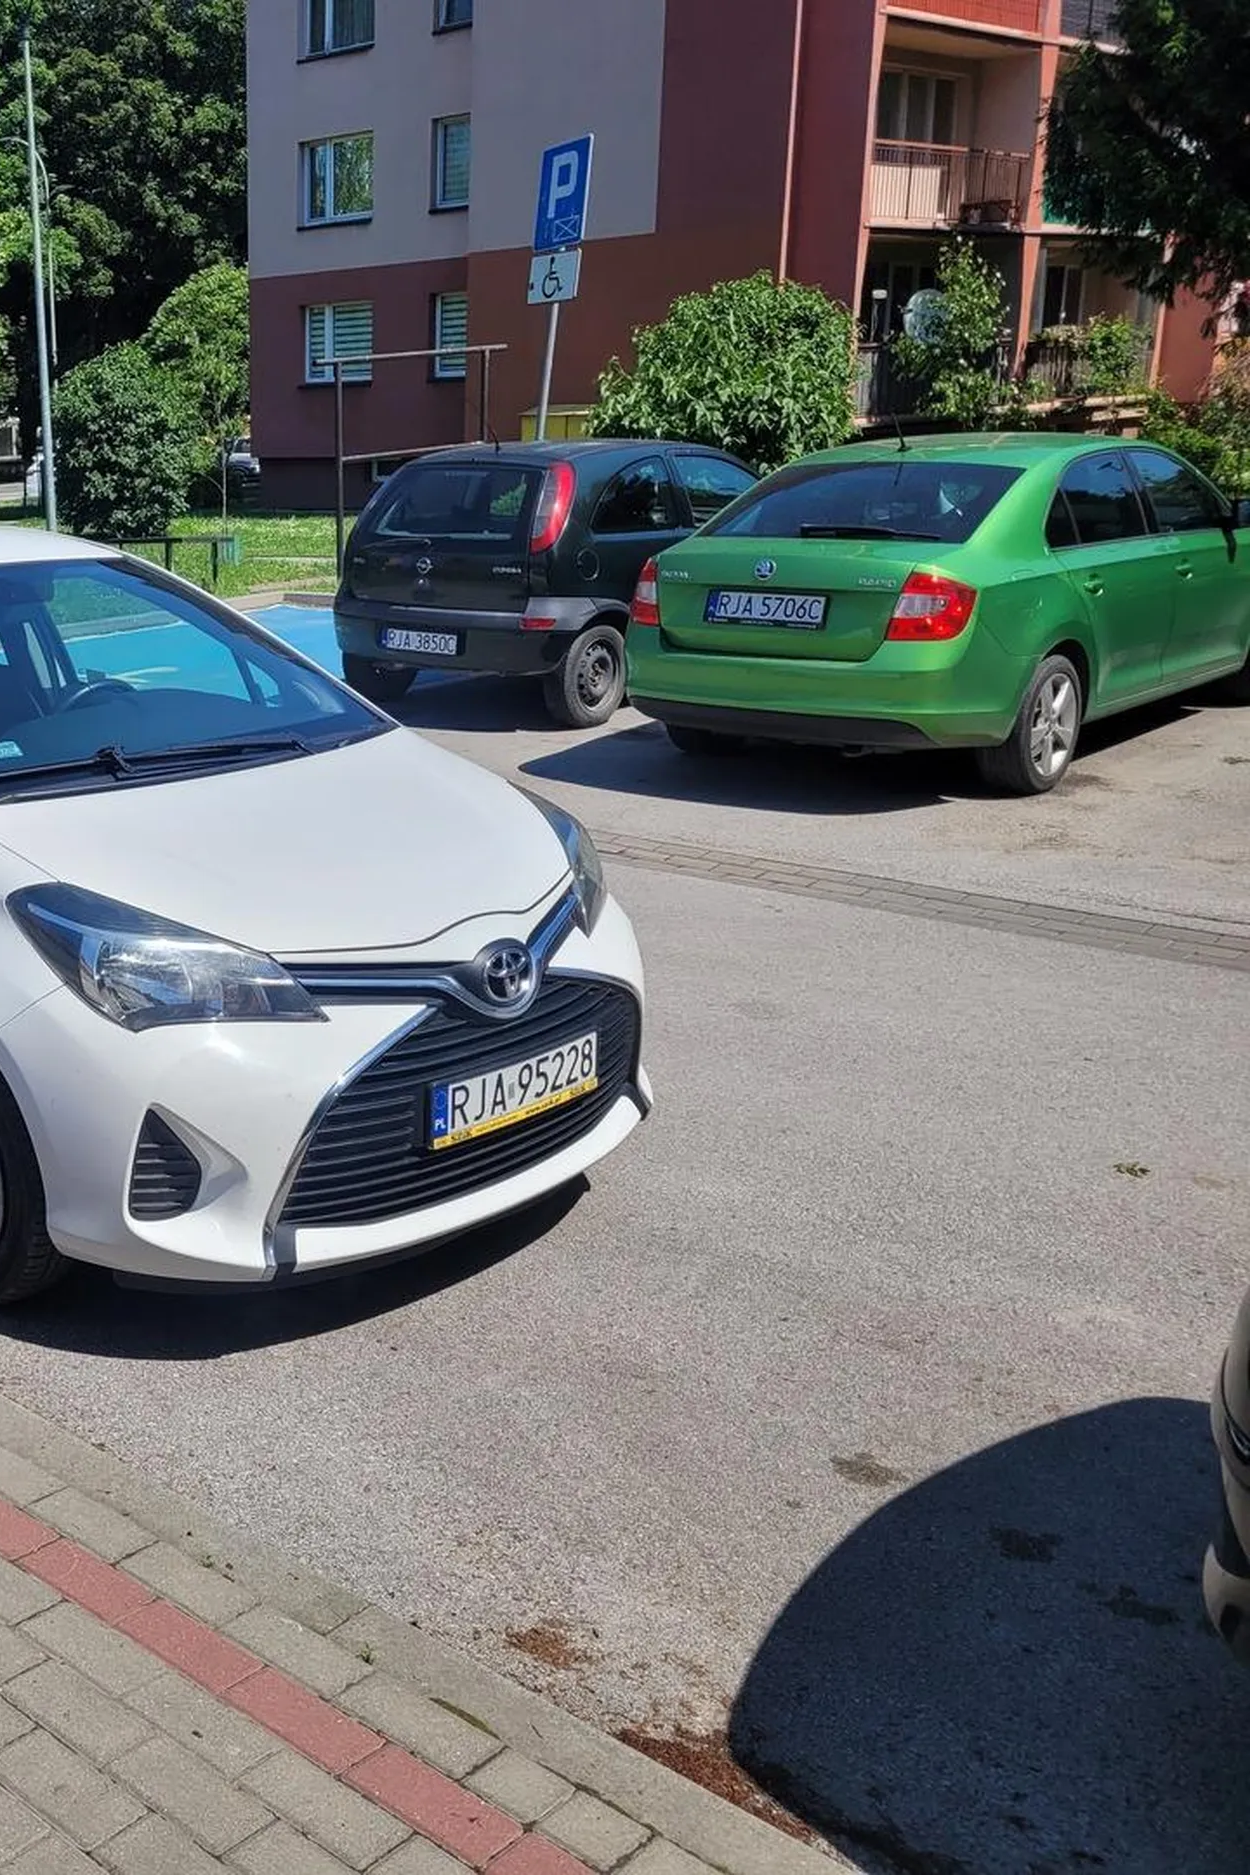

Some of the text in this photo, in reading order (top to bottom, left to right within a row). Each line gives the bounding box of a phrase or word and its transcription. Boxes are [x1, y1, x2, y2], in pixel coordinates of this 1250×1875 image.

[547, 150, 579, 219] P
[716, 594, 822, 621] RJA 5706C
[388, 630, 411, 648] RJA
[415, 634, 456, 653] 3850C
[452, 1039, 593, 1129] RJA 95228
[435, 1119, 447, 1131] PL
